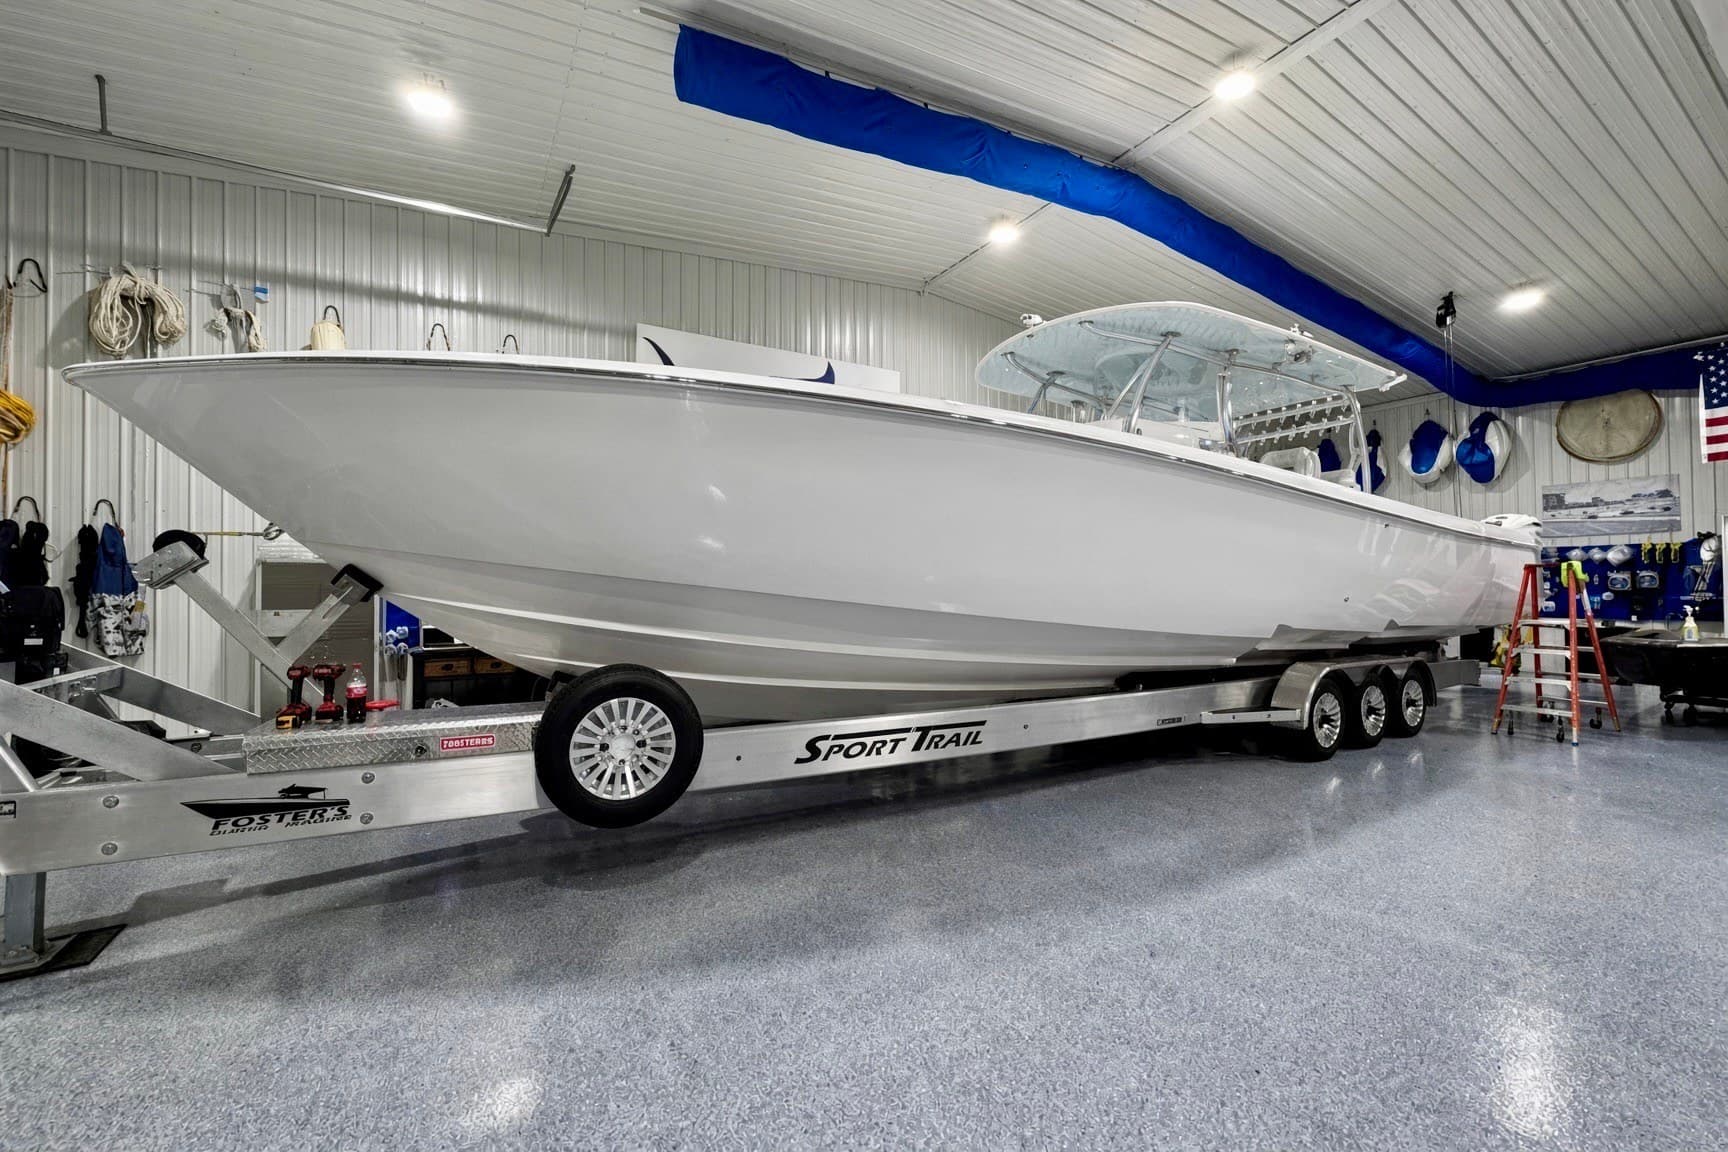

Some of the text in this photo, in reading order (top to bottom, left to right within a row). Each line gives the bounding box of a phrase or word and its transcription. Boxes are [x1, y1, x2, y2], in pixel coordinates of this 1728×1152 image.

[794, 720, 987, 764] SPORT TRAIL
[211, 805, 350, 831] FOSTER'S
